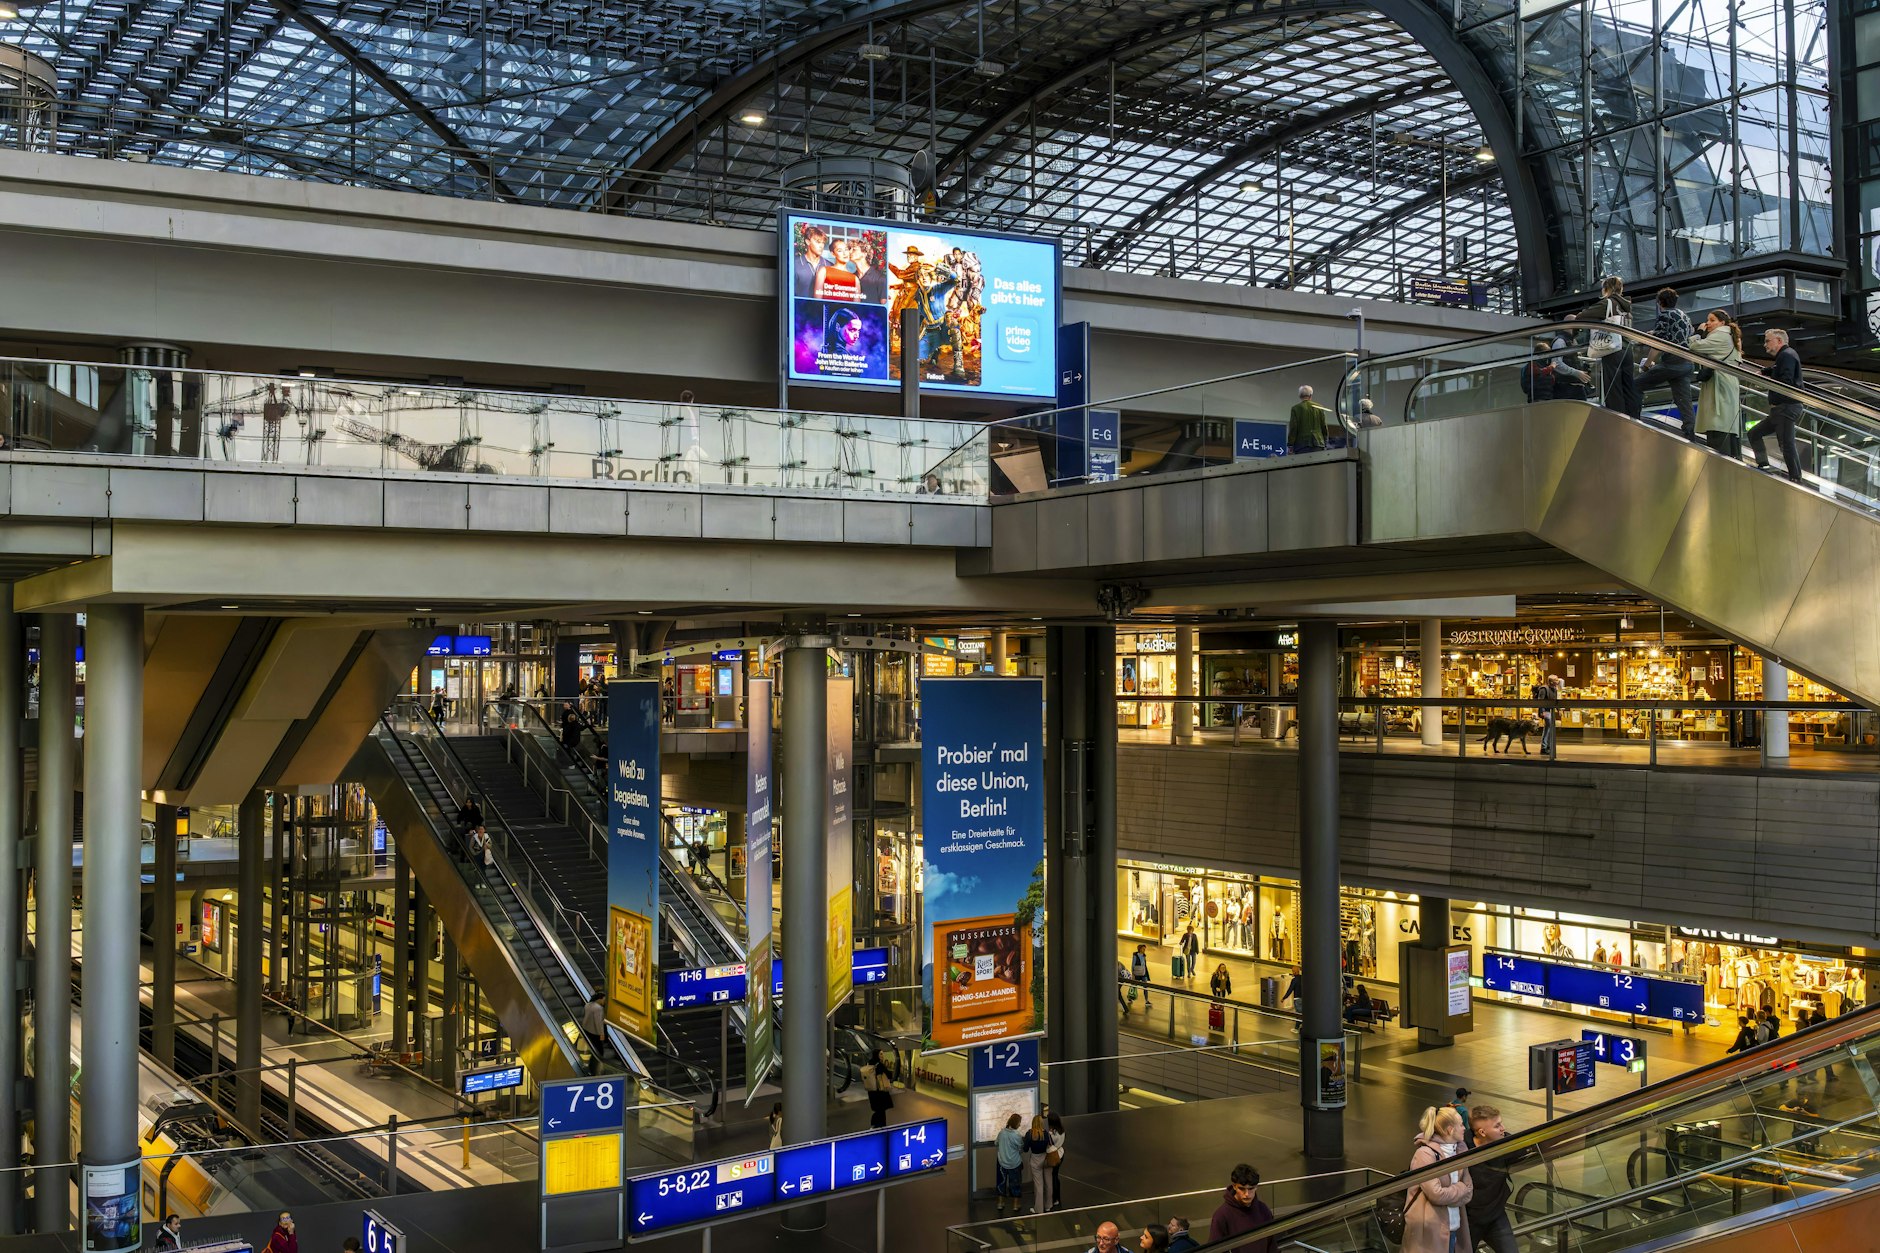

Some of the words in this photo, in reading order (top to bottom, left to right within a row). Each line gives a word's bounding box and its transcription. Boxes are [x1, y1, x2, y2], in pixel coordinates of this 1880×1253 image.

[994, 278, 1015, 291] Das
[1017, 281, 1042, 293] alles
[991, 292, 1021, 305] gibt's
[1023, 294, 1045, 307] hier
[1006, 327, 1031, 336] prime
[1007, 336, 1031, 346] video
[1092, 428, 1112, 440] E-G
[1242, 438, 1260, 450] A-E
[592, 458, 692, 483] Berlin
[938, 742, 996, 765] Probier'
[1001, 742, 1028, 762] mal
[619, 759, 636, 779] Weiß
[637, 767, 645, 780] zu
[936, 771, 977, 792] diese
[982, 771, 1029, 791] Union,
[614, 783, 650, 809] begeistern.
[960, 797, 1007, 818] Berlin!
[951, 830, 967, 840] Eine
[968, 827, 1005, 838] Dreierkette
[1006, 826, 1016, 836] für
[940, 842, 984, 854] erstklassigen
[985, 837, 1026, 850] Geschmack.
[1153, 863, 1169, 871] TOM
[1170, 865, 1198, 875] TAILOR
[952, 927, 1016, 942] NUSSKLASSE
[1399, 918, 1473, 942] CAES
[976, 968, 993, 976] SPORT
[1497, 957, 1515, 971] 1-4
[679, 970, 702, 982] 11-16
[1612, 974, 1633, 989] 1-2
[952, 987, 1017, 1003] HONIG-SALZ-MANDEL
[484, 1041, 492, 1053] 4
[1595, 1034, 1605, 1056] 4
[1620, 1039, 1634, 1061] 3
[984, 1043, 1020, 1069] 1-2
[567, 1083, 614, 1113] 7-8
[902, 1126, 926, 1147] 1-4
[731, 1164, 741, 1178] S
[759, 1158, 768, 1172] U
[658, 1170, 710, 1197] 5-8,22
[368, 1220, 377, 1253] 6
